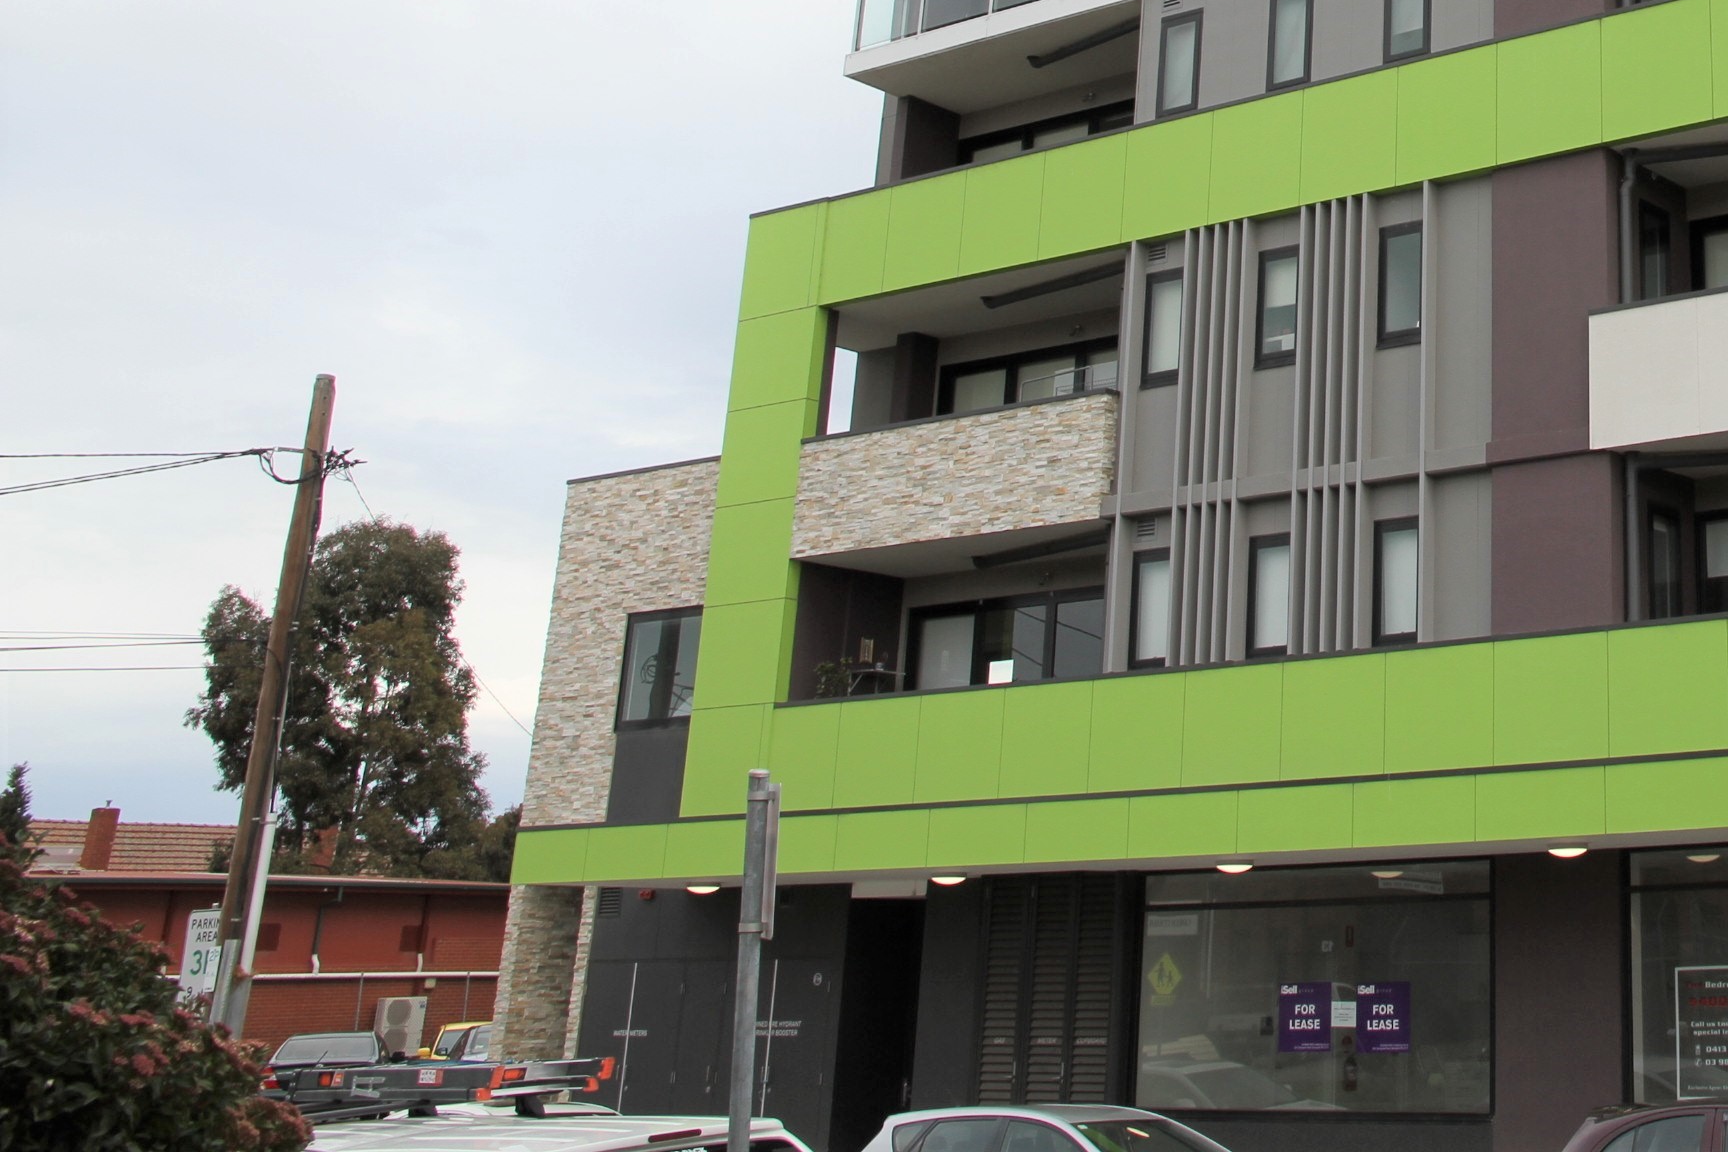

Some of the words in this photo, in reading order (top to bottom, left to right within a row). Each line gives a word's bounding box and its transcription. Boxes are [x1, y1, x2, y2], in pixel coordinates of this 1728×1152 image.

[191, 918, 220, 930] PARKIN
[1295, 1004, 1316, 1015] FOR
[1373, 1004, 1394, 1015] FOR
[1289, 1019, 1320, 1030] LEASE
[1367, 1019, 1400, 1030] LEASE
